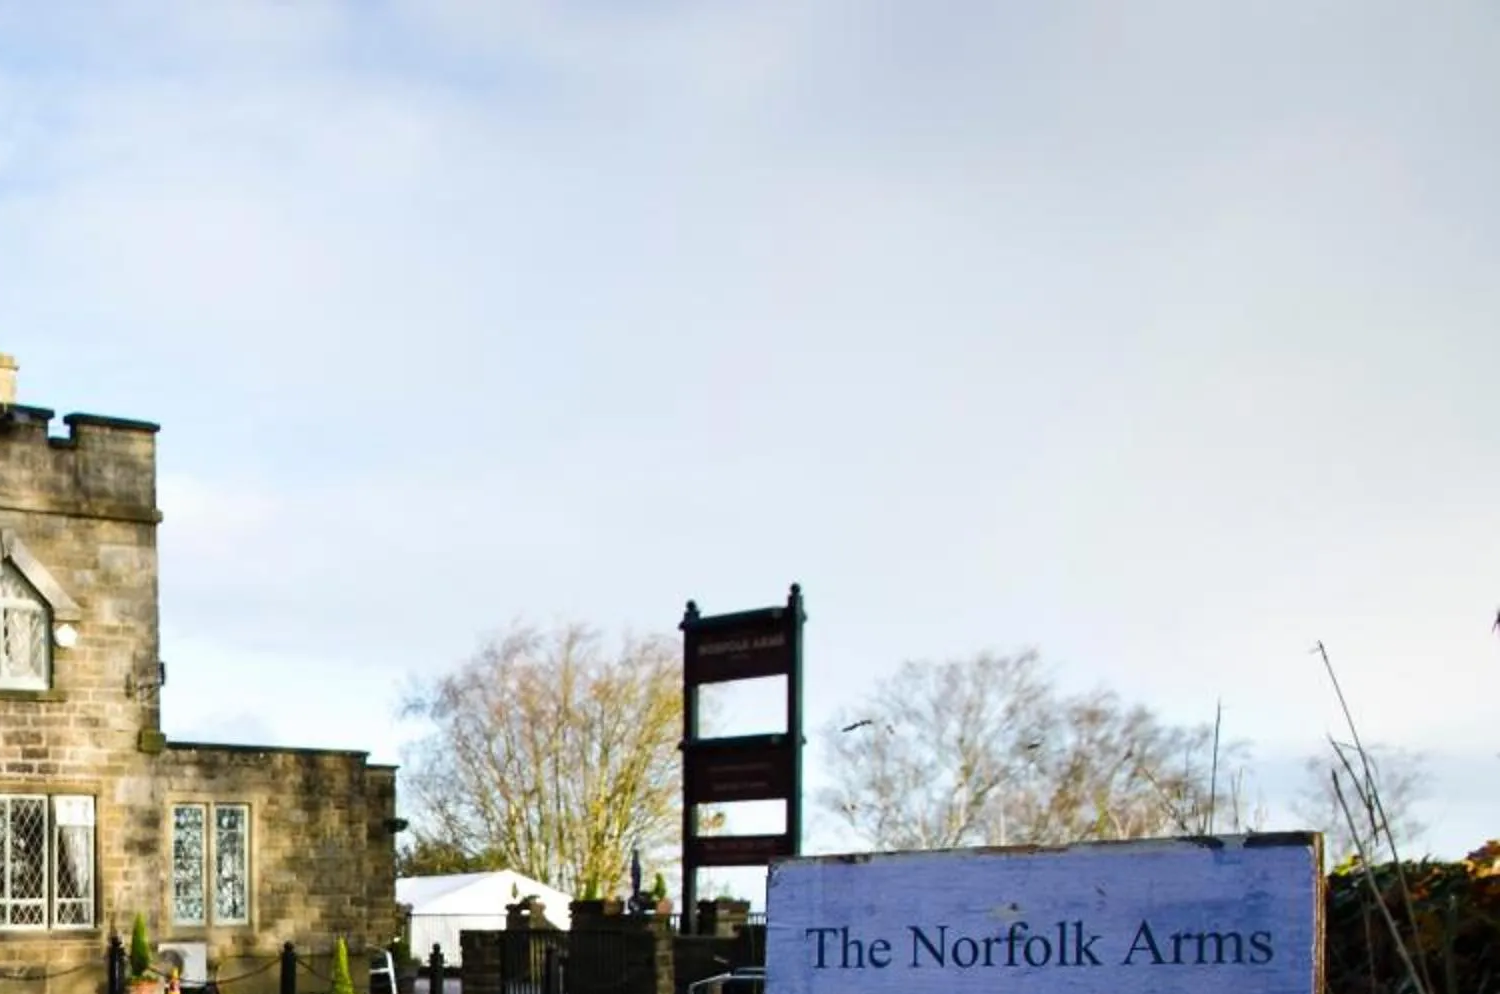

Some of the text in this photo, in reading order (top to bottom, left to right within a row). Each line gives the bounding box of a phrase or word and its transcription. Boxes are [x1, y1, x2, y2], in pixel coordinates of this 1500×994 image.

[805, 919, 1275, 969] The Norfolk Arms
